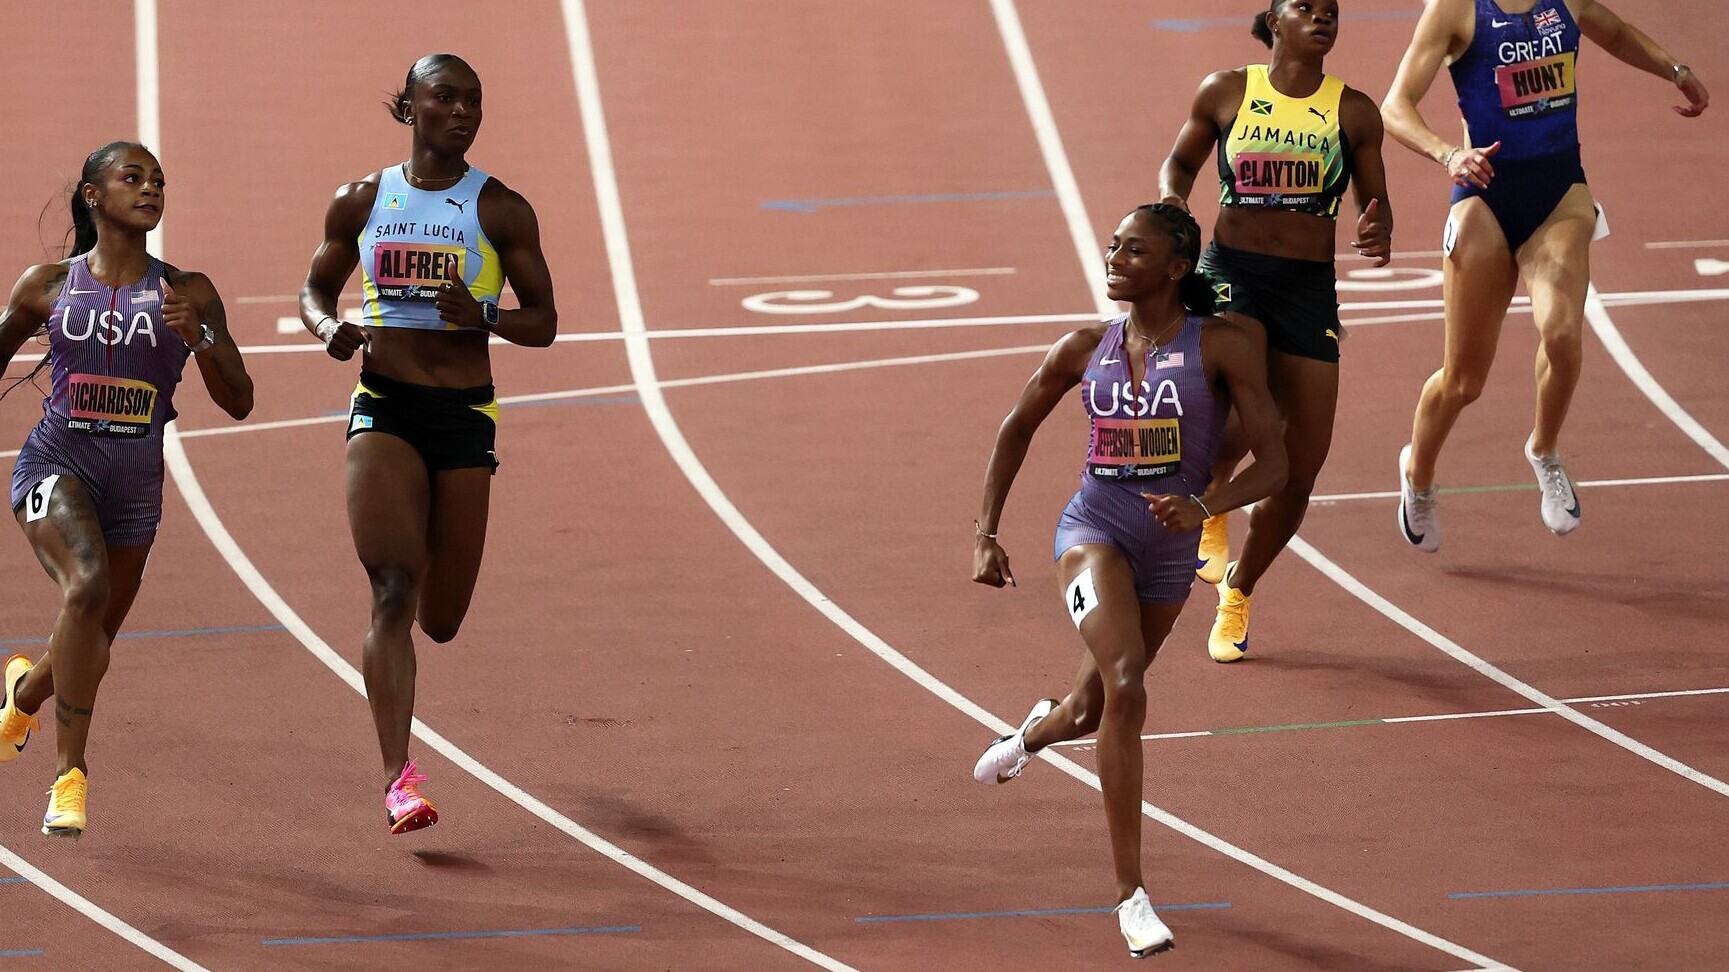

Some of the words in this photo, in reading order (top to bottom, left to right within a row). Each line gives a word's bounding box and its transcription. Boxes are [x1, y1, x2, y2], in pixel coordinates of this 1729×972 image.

[1499, 31, 1562, 63] GREAT
[1512, 62, 1565, 97] HUNT
[1238, 125, 1330, 153] JAMAICA
[1240, 160, 1319, 188] CLAYTON
[1239, 196, 1264, 204] ULTIMATE
[1282, 197, 1309, 205] BUDAPEST
[375, 223, 416, 238] SAINT
[424, 223, 464, 244] LUCIA
[380, 250, 459, 280] ALFRED
[741, 284, 981, 315] 3
[62, 306, 157, 347] USA
[1090, 379, 1183, 416] USA
[109, 425, 137, 434] BUDAPEST
[1095, 426, 1178, 457] JEFFERSON-WOODEN
[1095, 467, 1118, 476] ULTIMATE
[1137, 466, 1167, 476] BUDAPEST
[31, 481, 44, 514] 6
[1073, 584, 1085, 613] 4
